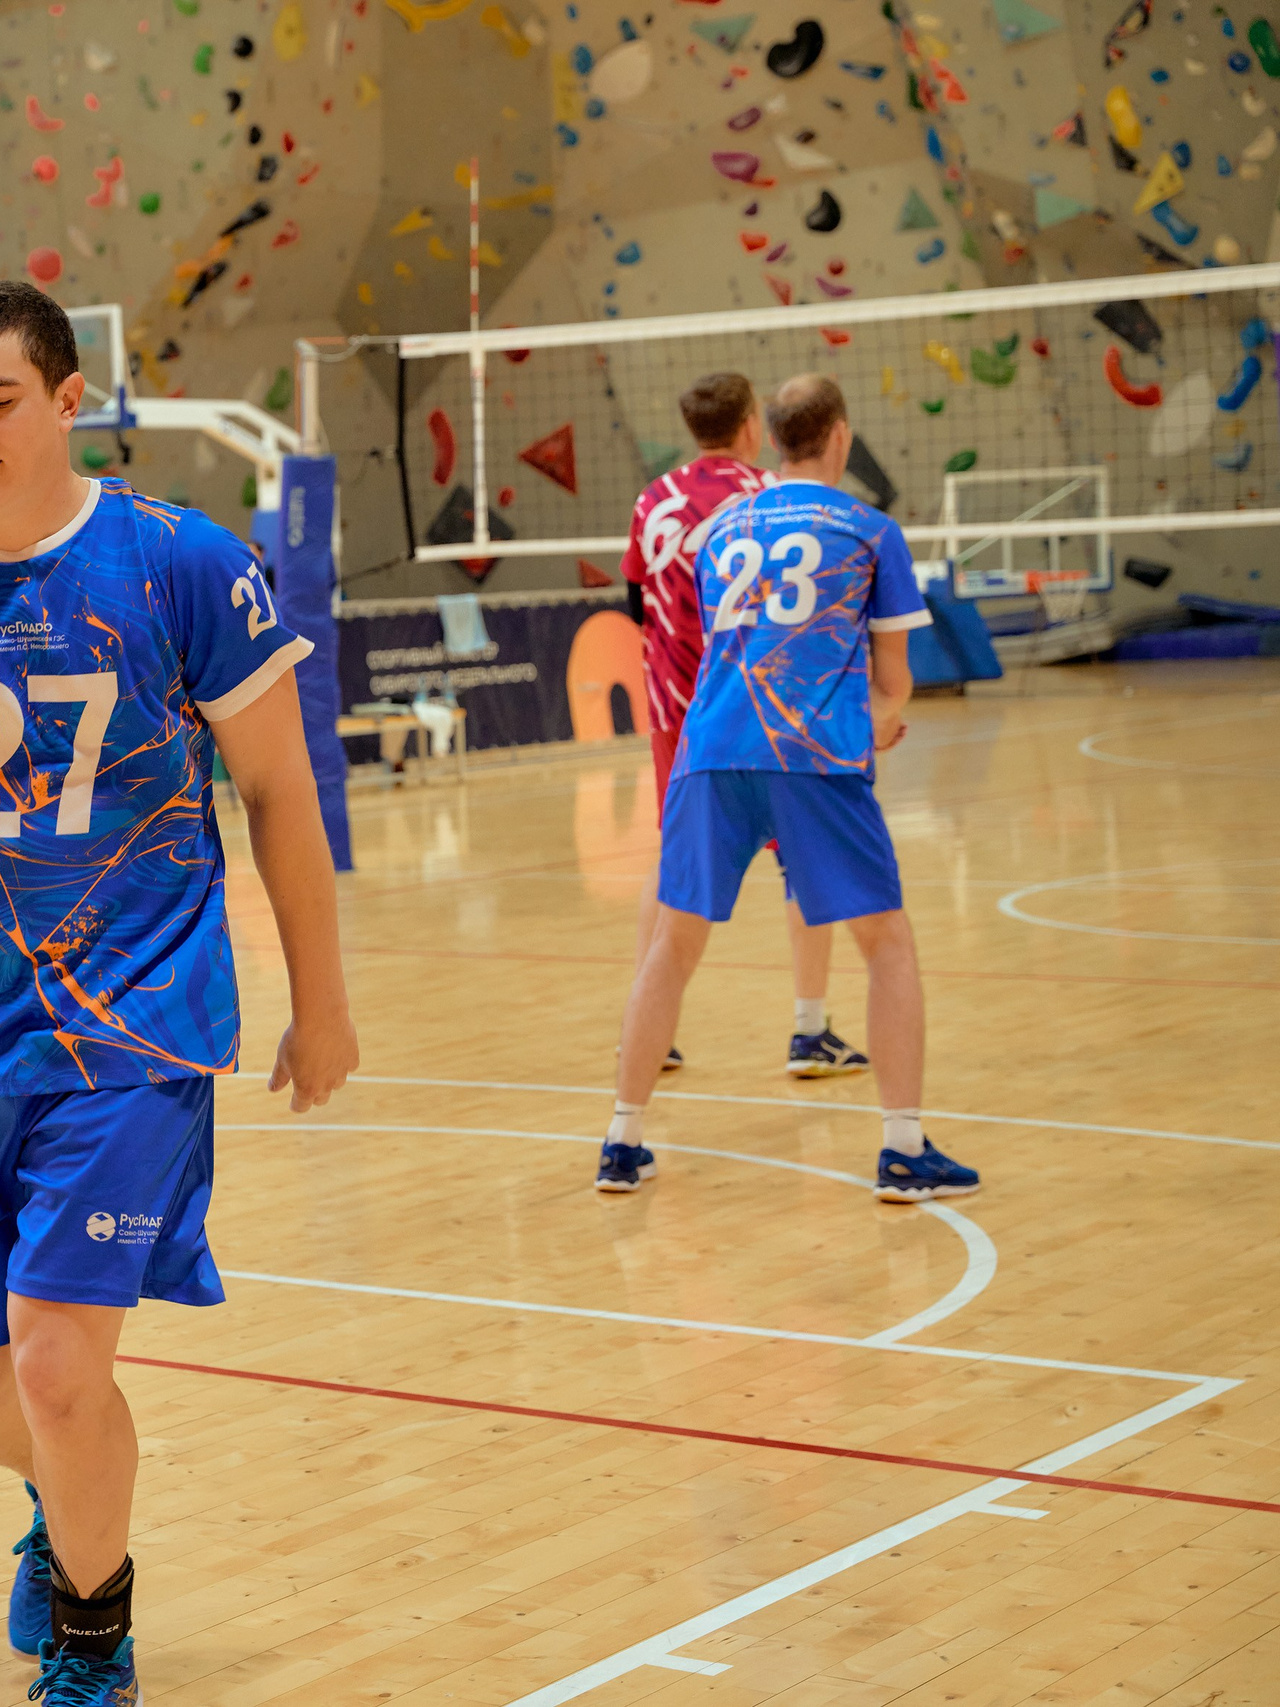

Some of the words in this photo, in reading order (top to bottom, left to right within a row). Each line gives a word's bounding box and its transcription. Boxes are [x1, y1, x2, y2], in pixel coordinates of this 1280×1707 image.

[230, 560, 278, 641] 27
[714, 532, 822, 632] 23
[120, 1213, 164, 1229] РусГидр
[67, 1623, 120, 1637] MUELLER
